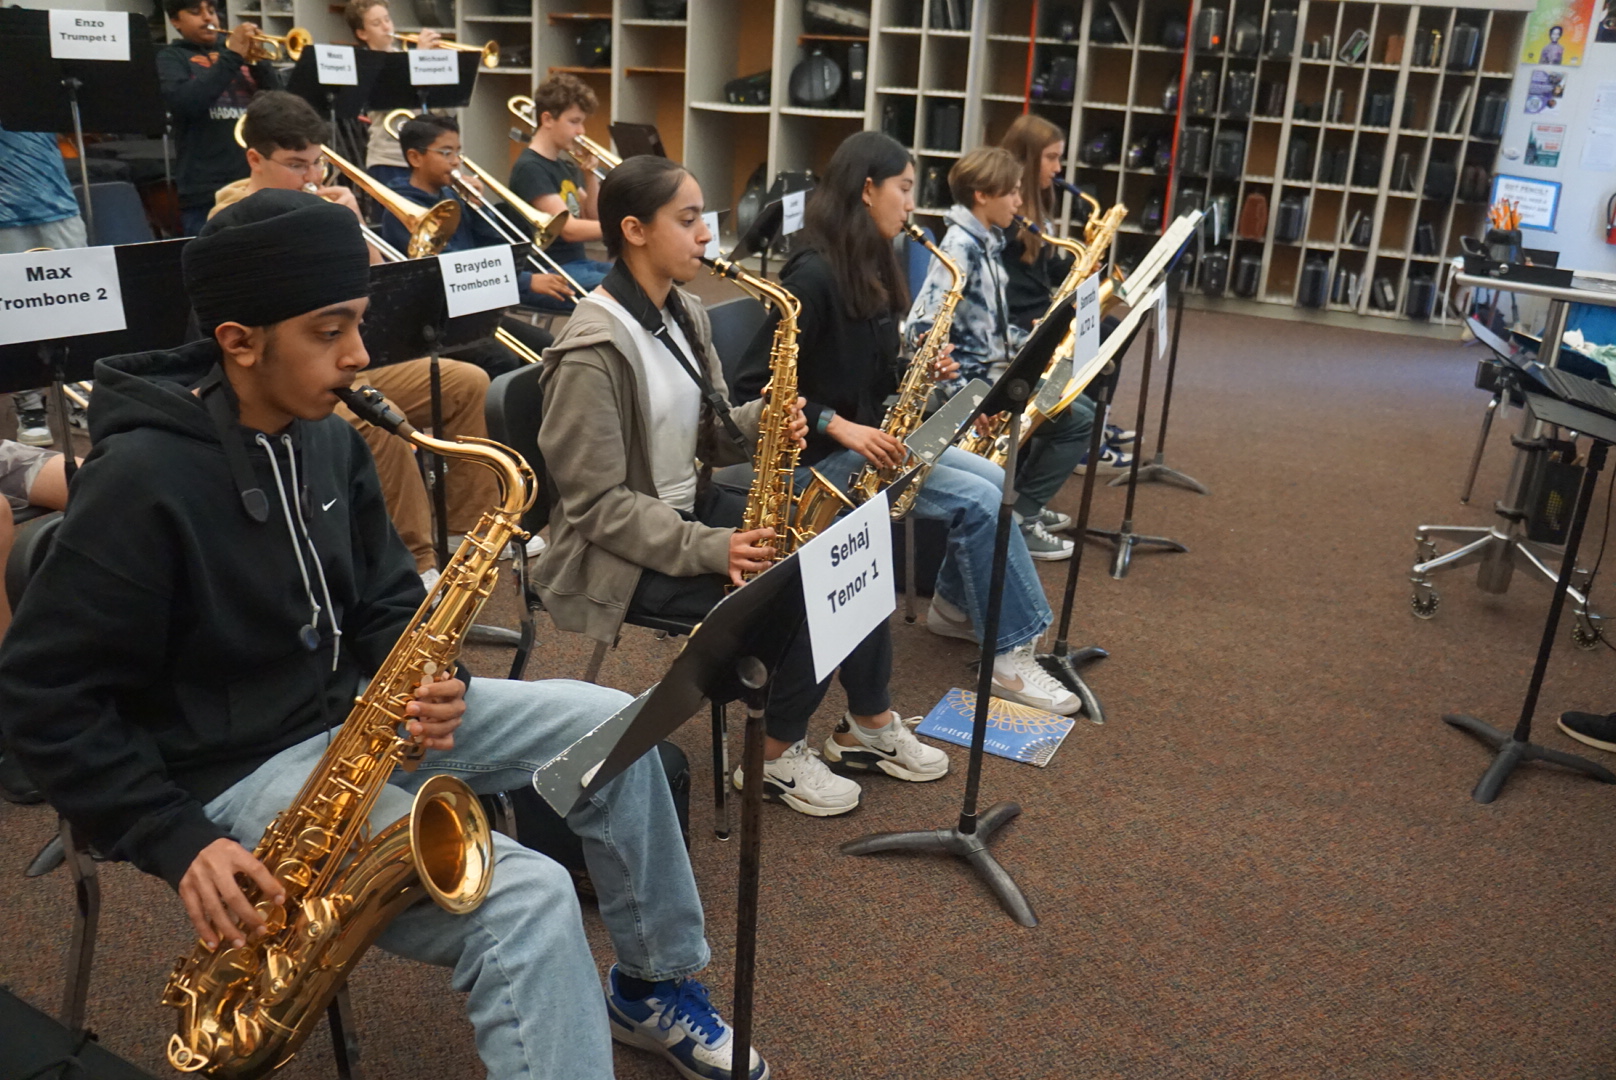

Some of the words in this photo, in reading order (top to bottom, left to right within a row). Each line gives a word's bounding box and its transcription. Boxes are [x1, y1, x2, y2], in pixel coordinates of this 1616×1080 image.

[75, 18, 104, 28] Enzo
[59, 32, 107, 42] Trumpet
[111, 34, 116, 42] 1
[320, 63, 345, 73] Trumpet
[414, 66, 445, 74] Trumpet
[454, 258, 502, 273] Brayden
[26, 266, 72, 282] Max
[449, 276, 501, 293] Trombone
[504, 274, 510, 283] 1
[96, 287, 108, 300] 2
[830, 522, 870, 567] Sehaj
[827, 570, 867, 614] Tenor
[871, 558, 879, 580] 1
